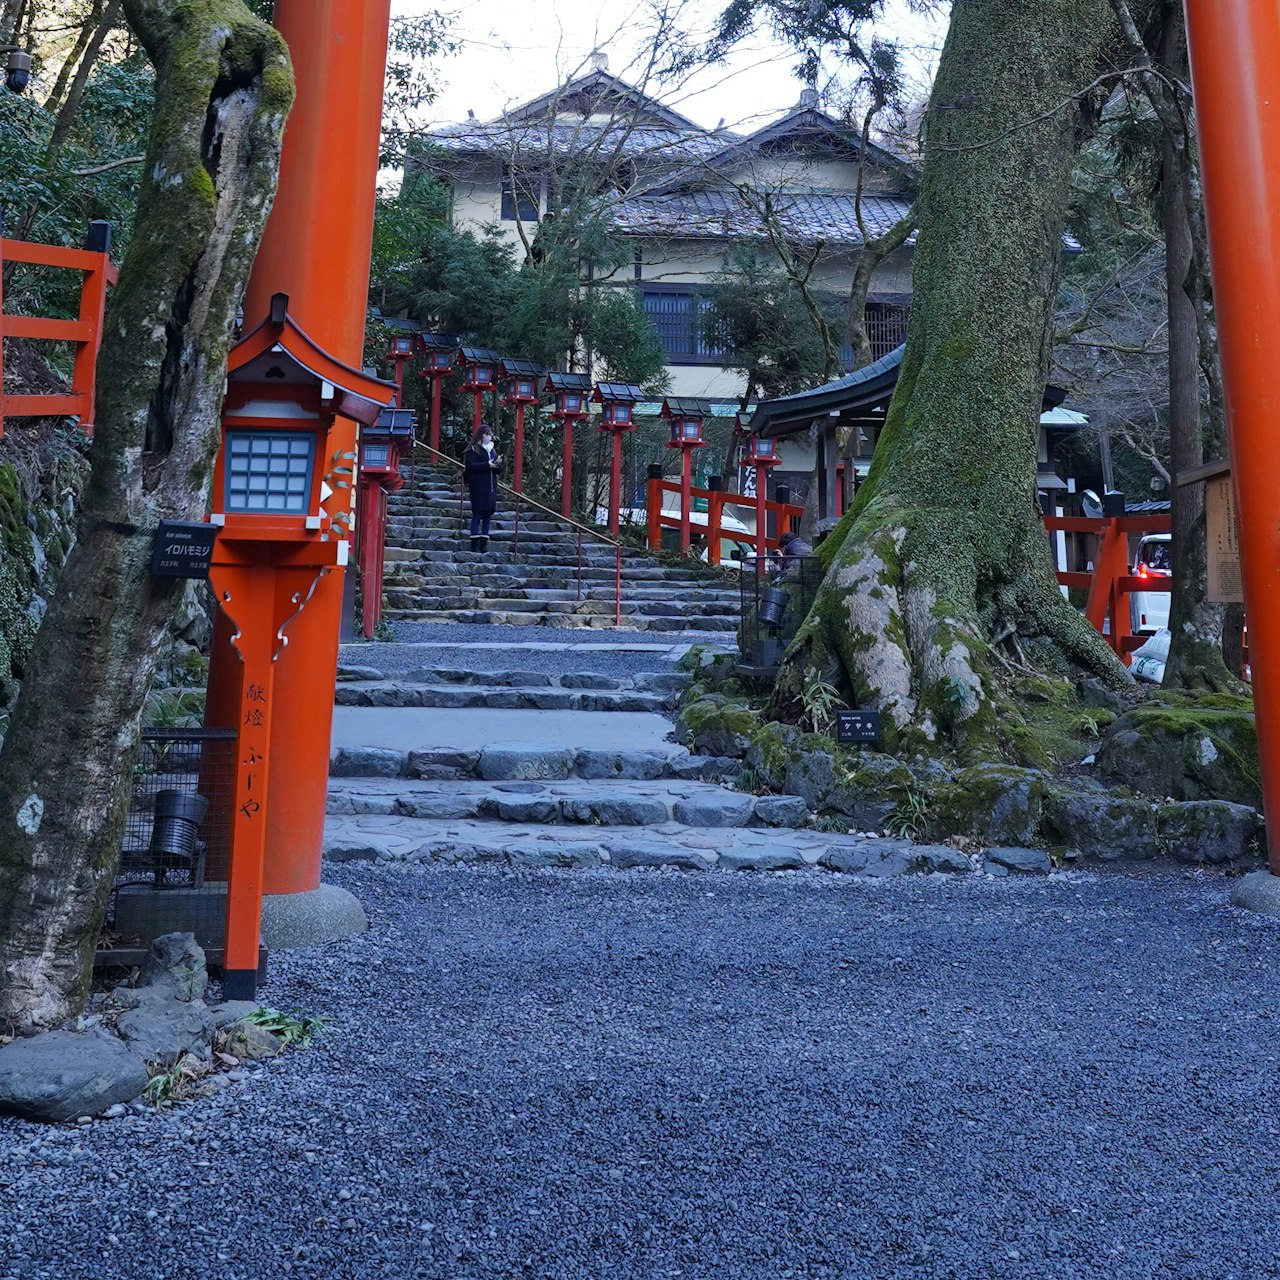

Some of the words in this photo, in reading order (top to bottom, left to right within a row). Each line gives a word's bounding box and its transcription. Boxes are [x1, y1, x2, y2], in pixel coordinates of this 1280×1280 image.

[165, 544, 210, 557] イロハモミジ
